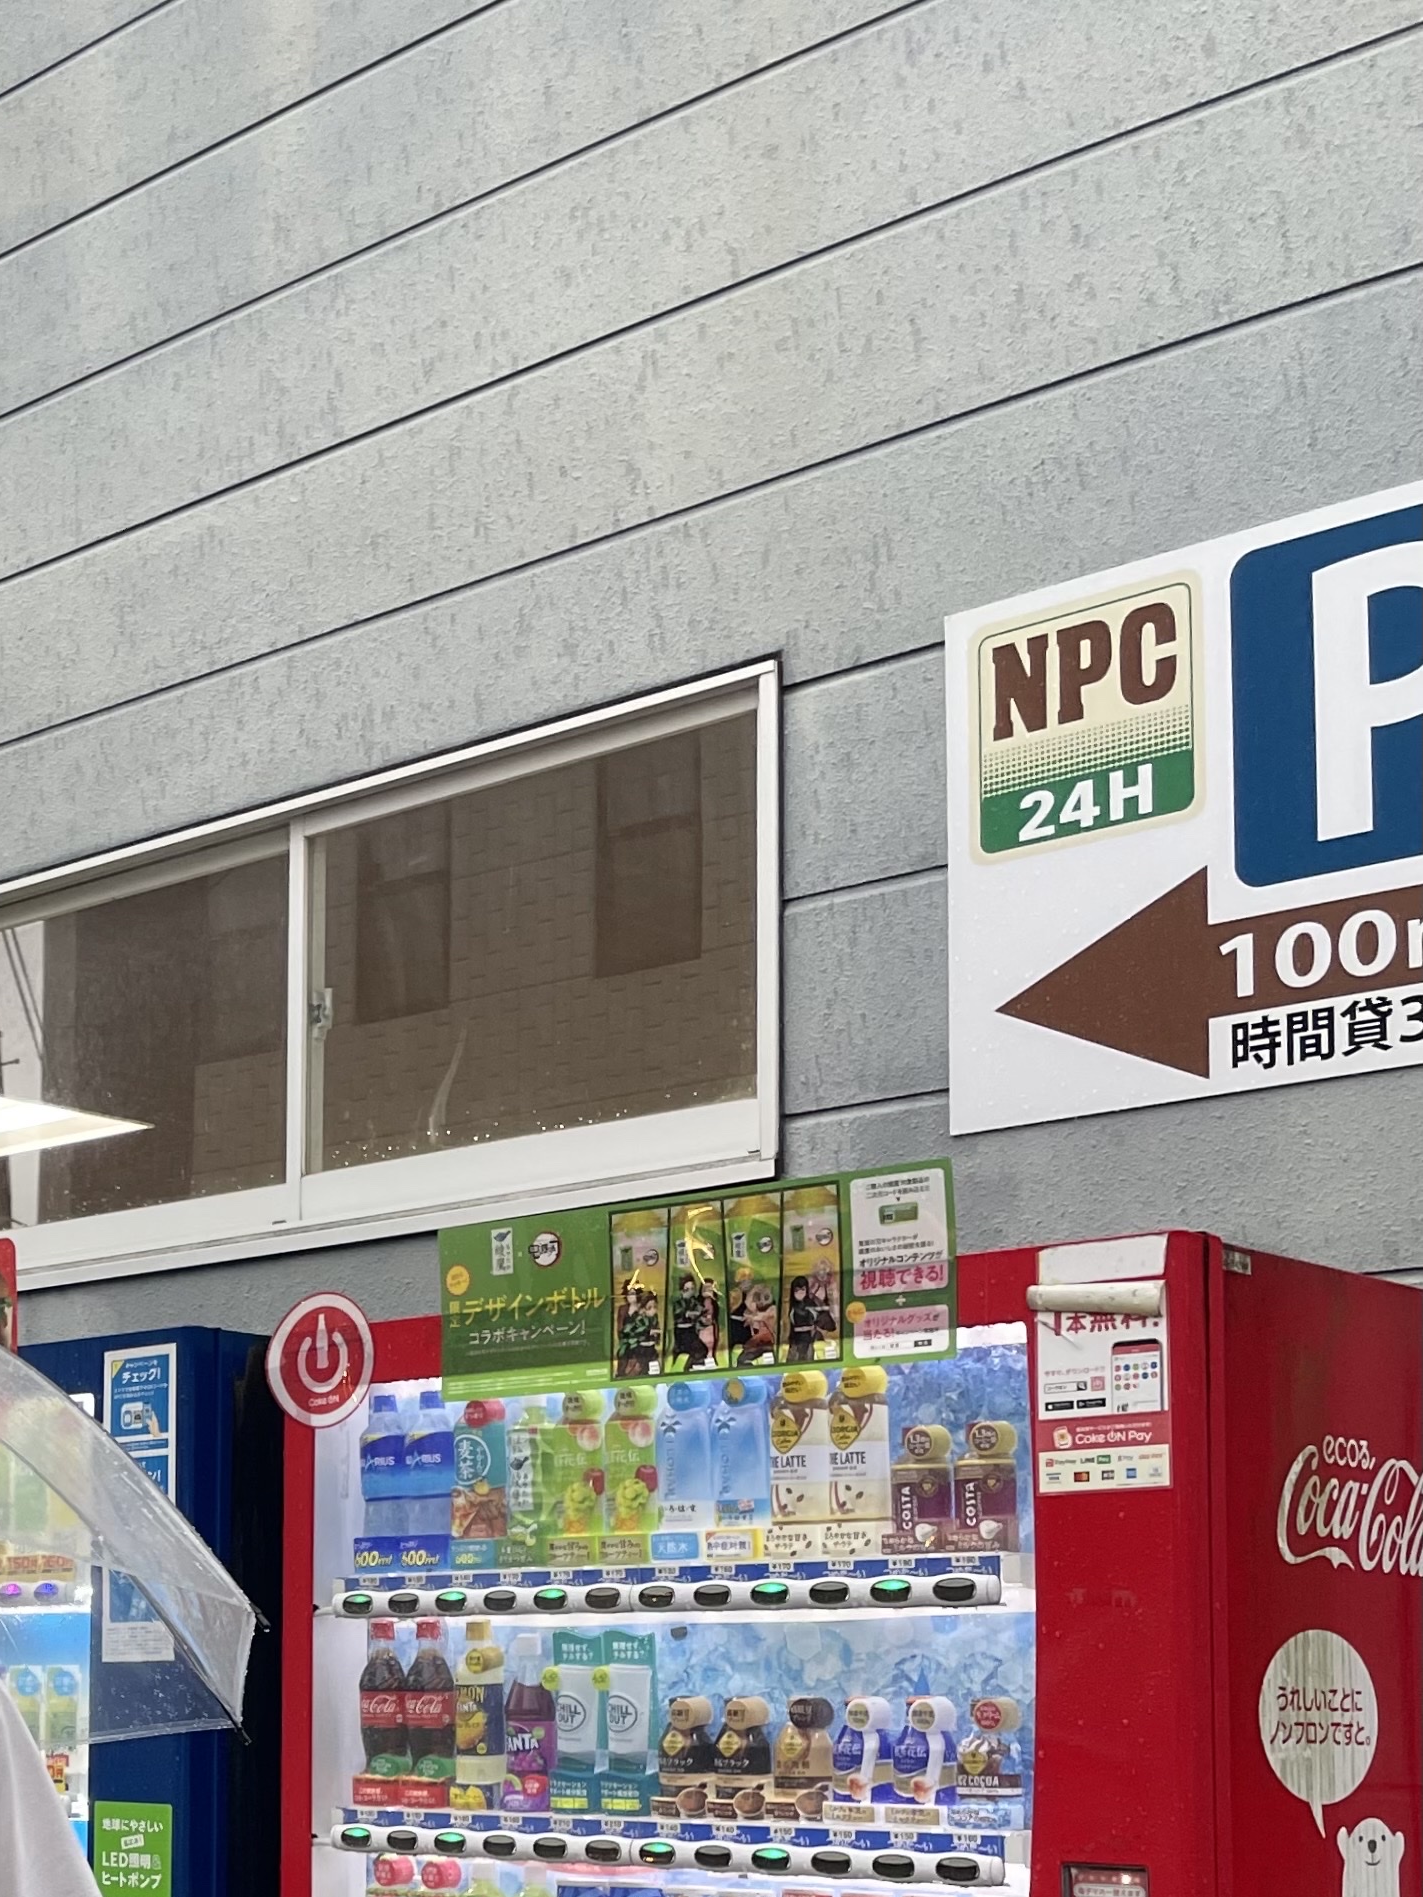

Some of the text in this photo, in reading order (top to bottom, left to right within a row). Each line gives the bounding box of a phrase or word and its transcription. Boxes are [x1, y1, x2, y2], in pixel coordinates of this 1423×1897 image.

[991, 601, 1179, 742] NPC
[1018, 763, 1155, 842] 24H
[1218, 909, 1423, 999] 100
[860, 1264, 944, 1290] 視聴できる!
[462, 1287, 606, 1326] デザインボトル
[468, 1320, 586, 1345] コラボキャンペーン!
[122, 1367, 160, 1384] チェック!
[1128, 1430, 1152, 1443] Pay
[457, 1440, 474, 1480] 麦茶
[781, 1455, 807, 1468] LATTE
[840, 1452, 866, 1465] LATTE
[901, 1486, 913, 1530] COSTA
[965, 1482, 976, 1526] COSTA
[1276, 1687, 1363, 1713] うれしいことに
[1269, 1721, 1372, 1747] ノンフロンですと。
[969, 1775, 999, 1787] COCOA
[102, 1817, 164, 1833] 地球にやさしい
[102, 1870, 162, 1889] ヒートポンプ
